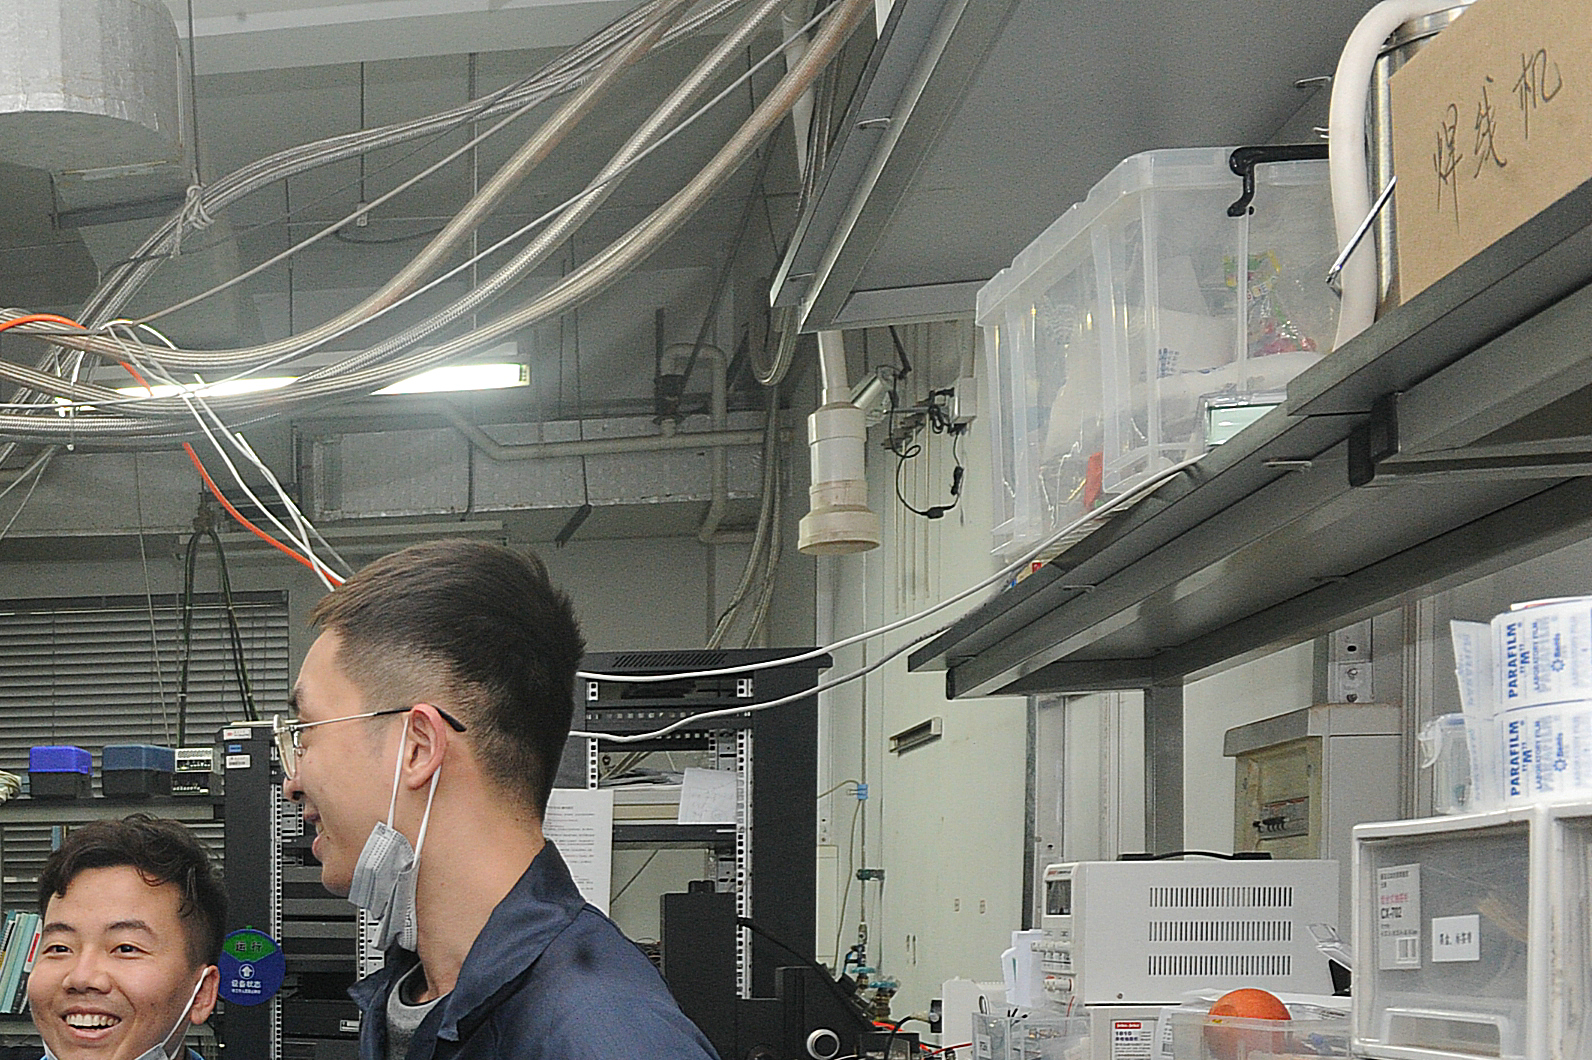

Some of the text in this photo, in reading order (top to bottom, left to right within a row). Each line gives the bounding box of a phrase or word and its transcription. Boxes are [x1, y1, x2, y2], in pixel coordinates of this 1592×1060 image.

[1506, 622, 1519, 698] PARAFILM
[1509, 720, 1521, 796] PARAFILM
[235, 941, 262, 952] 运行
[231, 979, 261, 989] 设备状态
